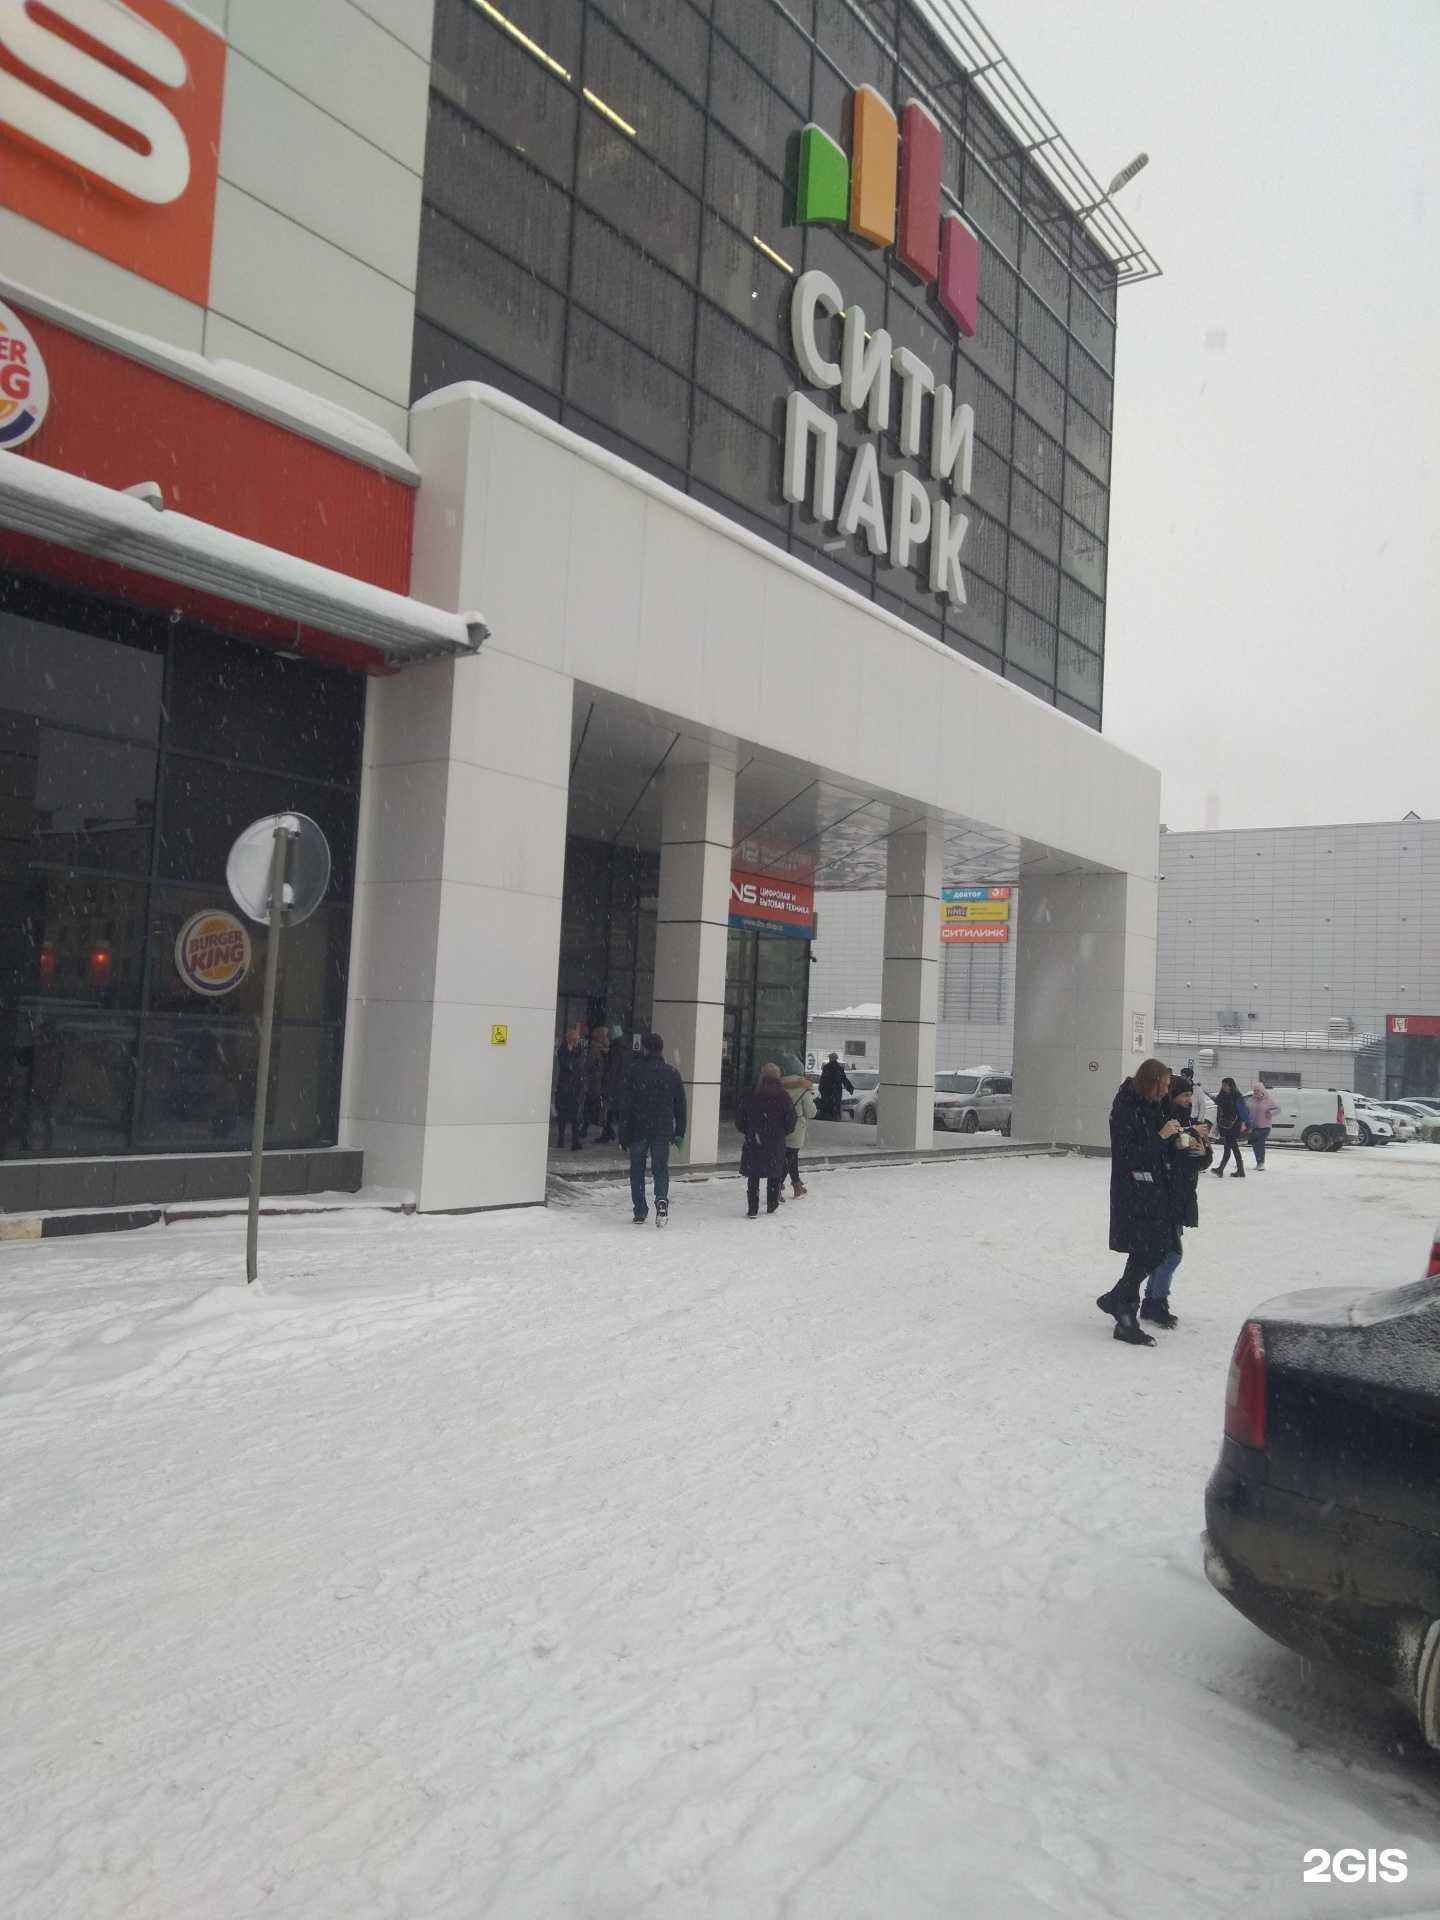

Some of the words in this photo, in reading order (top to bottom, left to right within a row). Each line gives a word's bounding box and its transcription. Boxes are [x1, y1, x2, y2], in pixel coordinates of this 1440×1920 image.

[791, 270, 974, 496] СИТИ
[783, 391, 969, 604] ПАРК
[760, 887, 791, 900] ЦИФРОВАЯ
[759, 897, 785, 910] БЫТОВАЯ
[786, 903, 809, 914] ТЕХНИКА
[190, 930, 242, 952] BURGER
[943, 927, 1004, 937] СИТИЛИНК
[190, 944, 244, 970] KING
